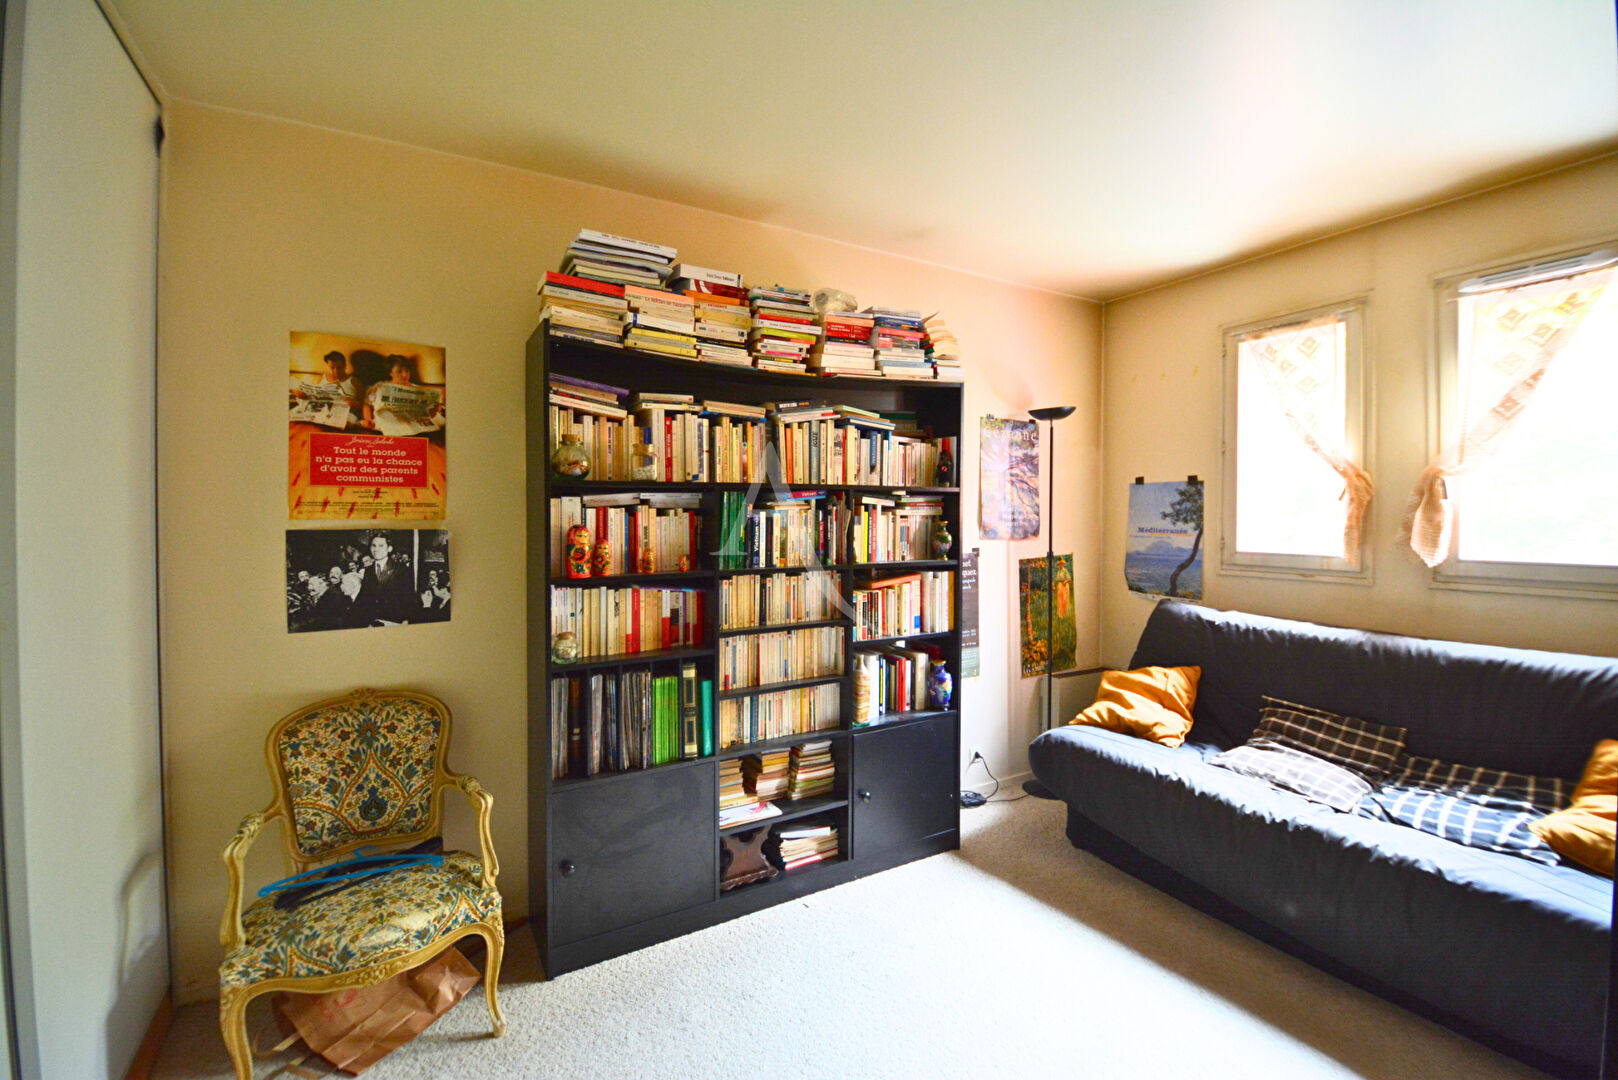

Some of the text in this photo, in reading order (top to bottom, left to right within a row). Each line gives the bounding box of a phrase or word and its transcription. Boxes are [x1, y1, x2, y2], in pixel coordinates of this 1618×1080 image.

[333, 446, 406, 457] Tout le monde
[335, 456, 354, 465] pas
[373, 457, 383, 465] la
[386, 458, 423, 466] chance
[320, 464, 419, 475] d'avoir des parents
[336, 475, 404, 483] communistes
